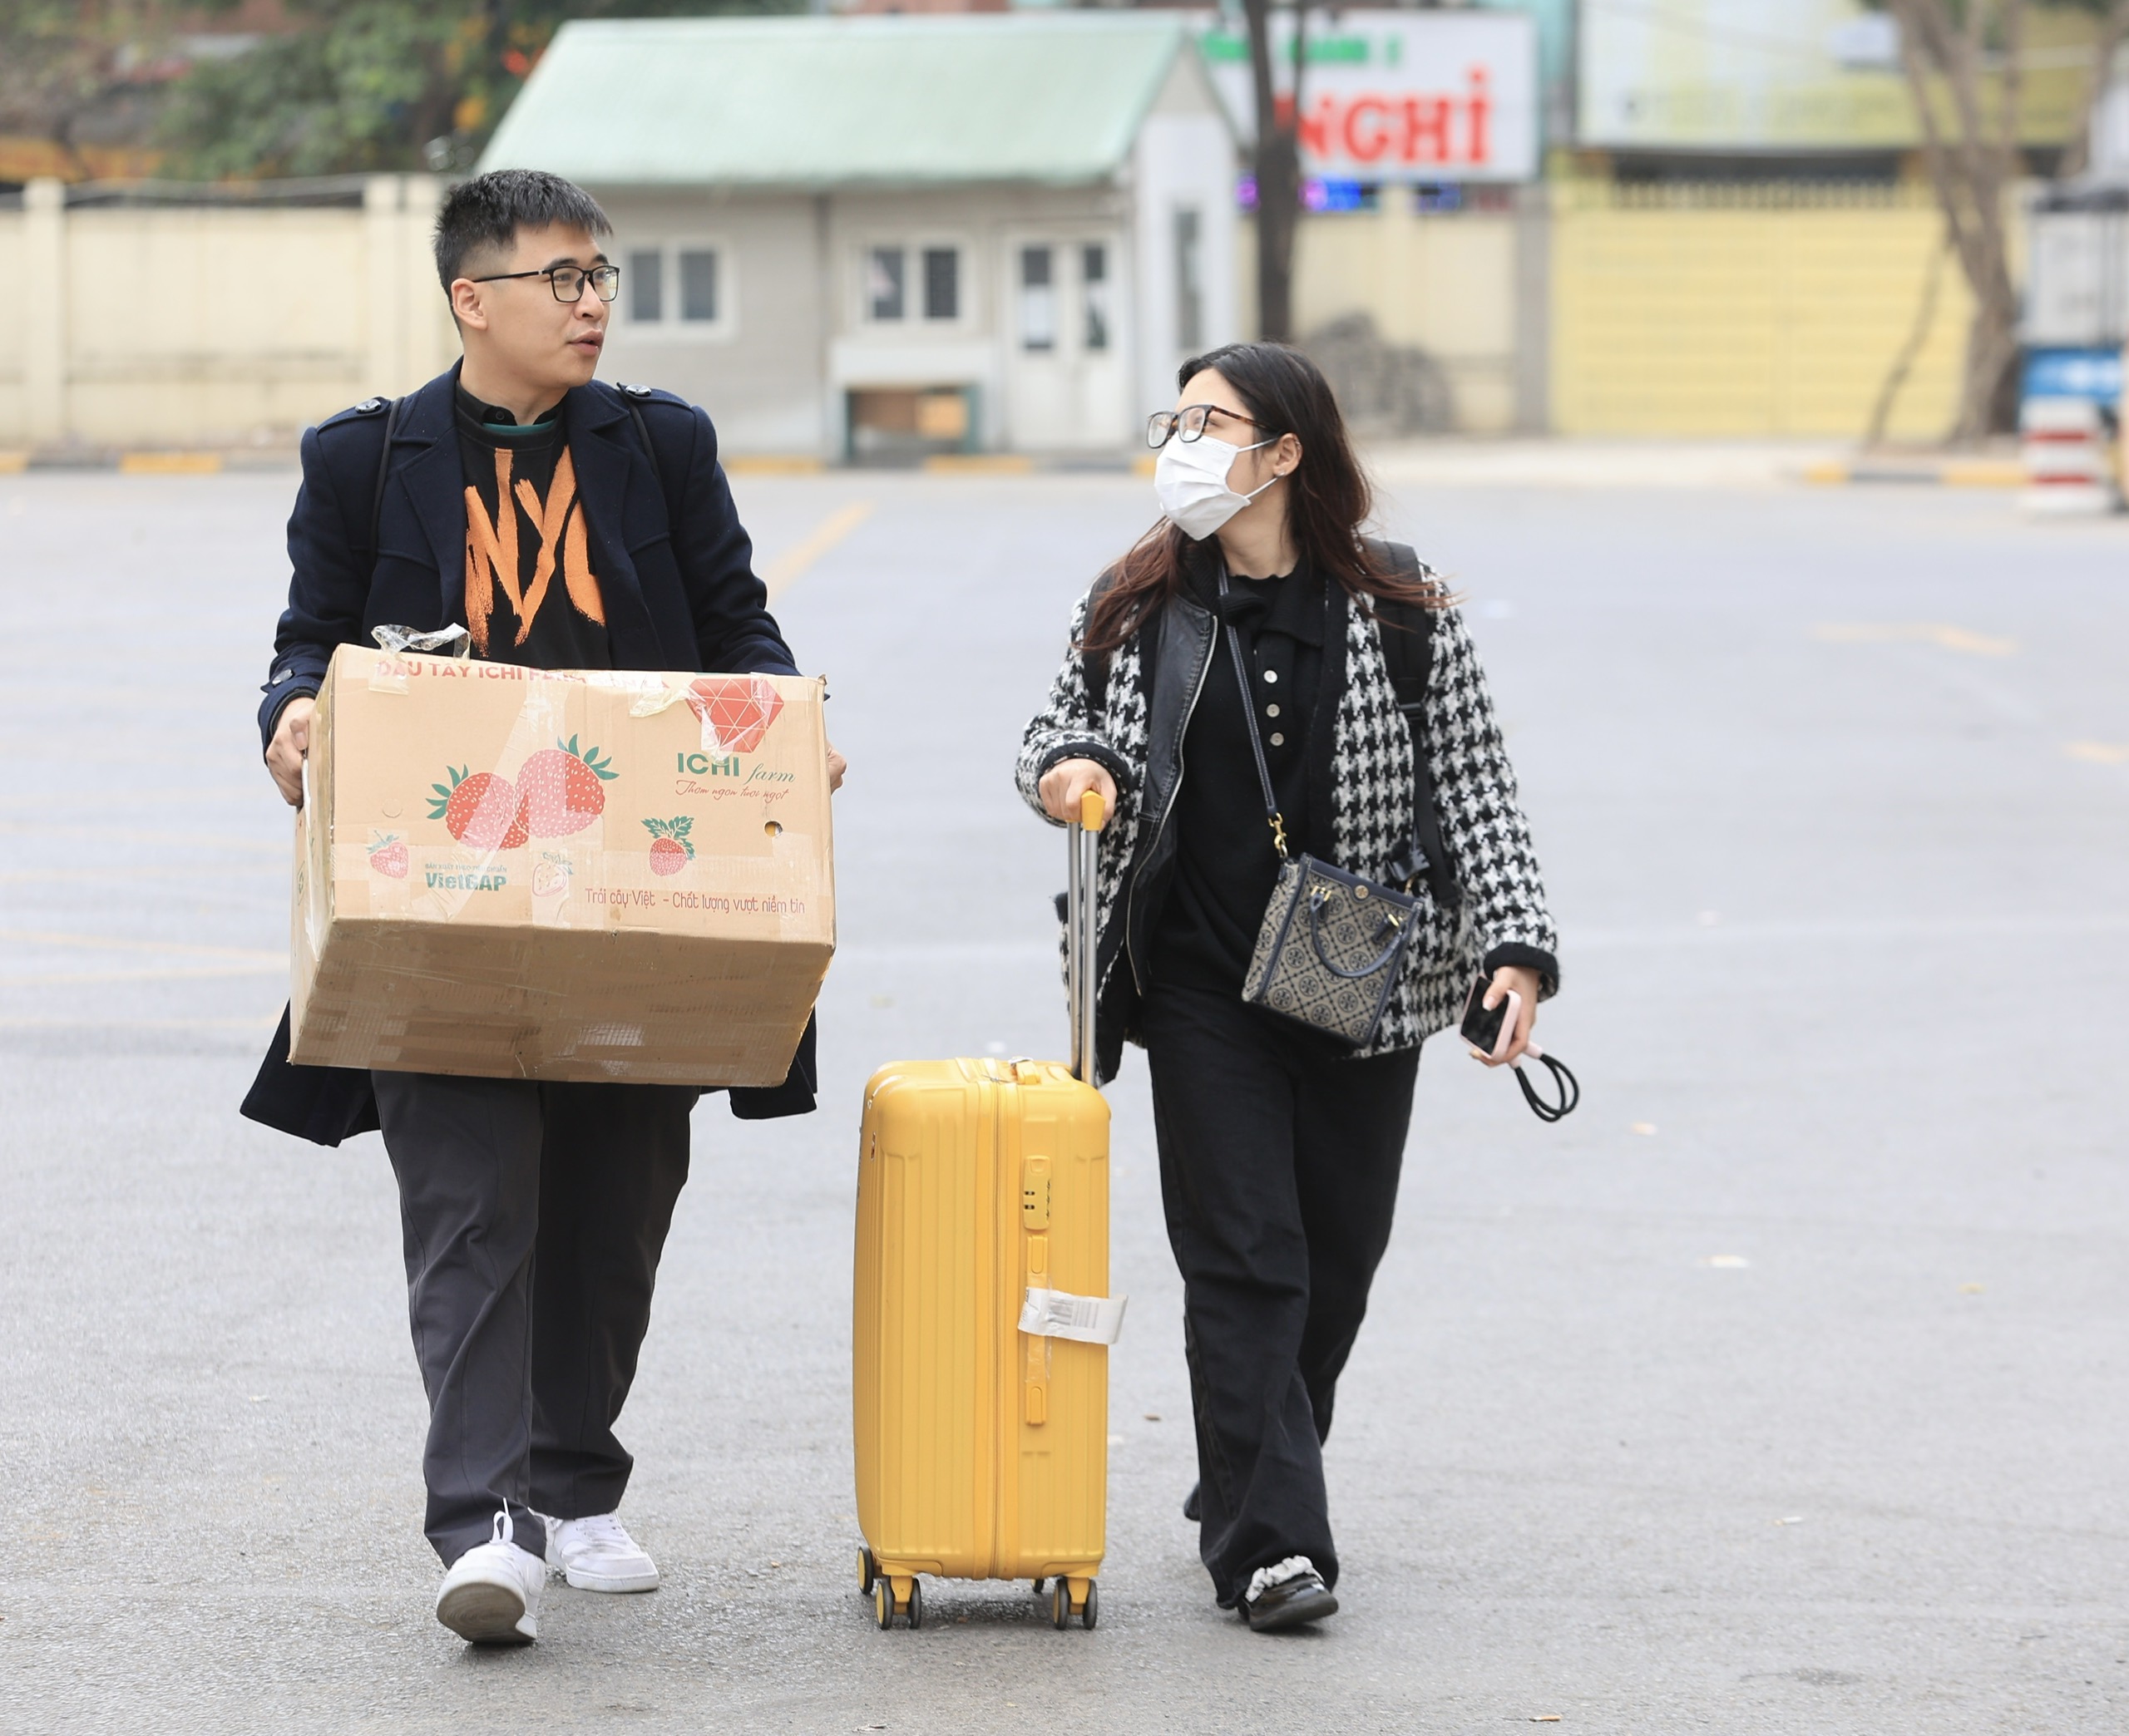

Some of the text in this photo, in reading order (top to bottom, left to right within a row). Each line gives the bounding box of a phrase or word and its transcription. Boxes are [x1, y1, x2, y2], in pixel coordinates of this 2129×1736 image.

[478, 666, 522, 680] ICHI
[677, 752, 796, 785] ICHI farm
[712, 788, 738, 801] ngon
[425, 872, 506, 891] VietGAP
[585, 888, 606, 904] Trái
[610, 889, 629, 909] cây
[632, 890, 655, 910] Việt
[672, 890, 699, 909] Chất
[702, 894, 730, 914] lượng
[733, 896, 758, 915] vượt
[790, 898, 805, 914] tin
